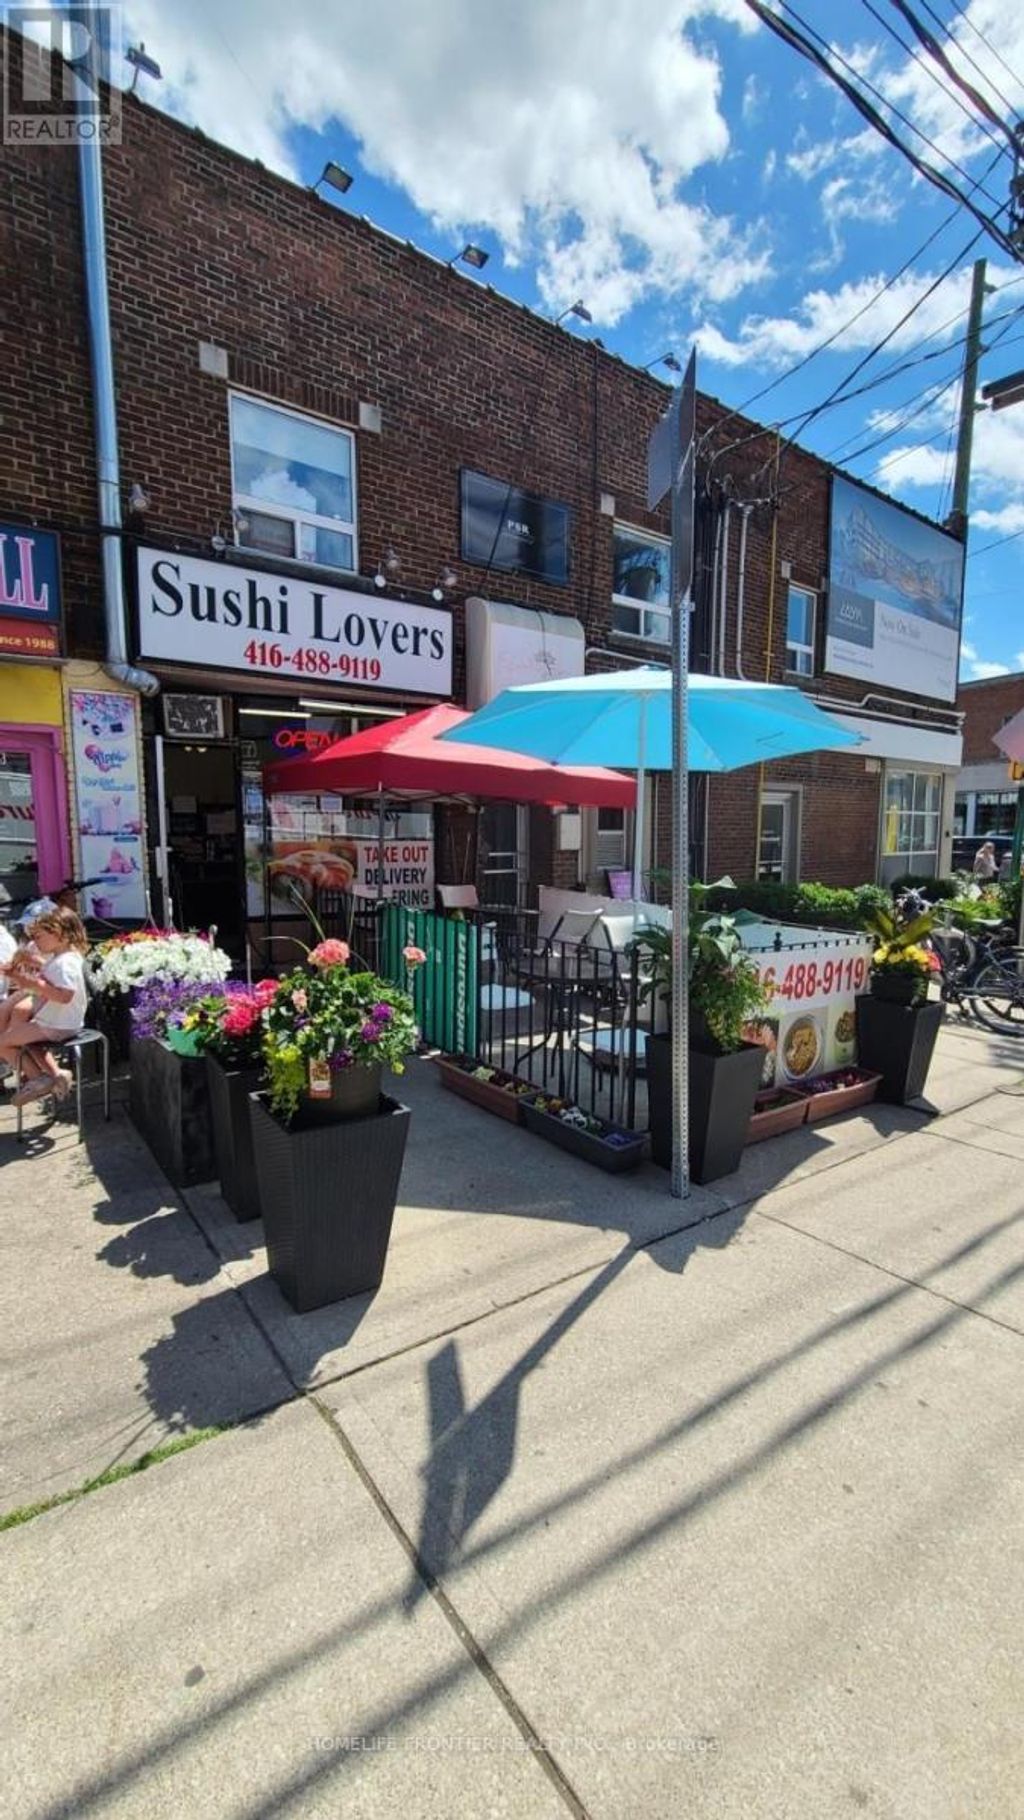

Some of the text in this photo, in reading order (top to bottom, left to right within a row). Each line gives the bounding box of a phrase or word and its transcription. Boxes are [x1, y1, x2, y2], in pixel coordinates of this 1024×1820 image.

[151, 560, 445, 660] Sushi Lovers
[243, 640, 381, 681] 416-488-9119
[275, 730, 340, 752] OPEN
[364, 846, 429, 863] TAKE OUT
[364, 867, 428, 885] DELIVERY
